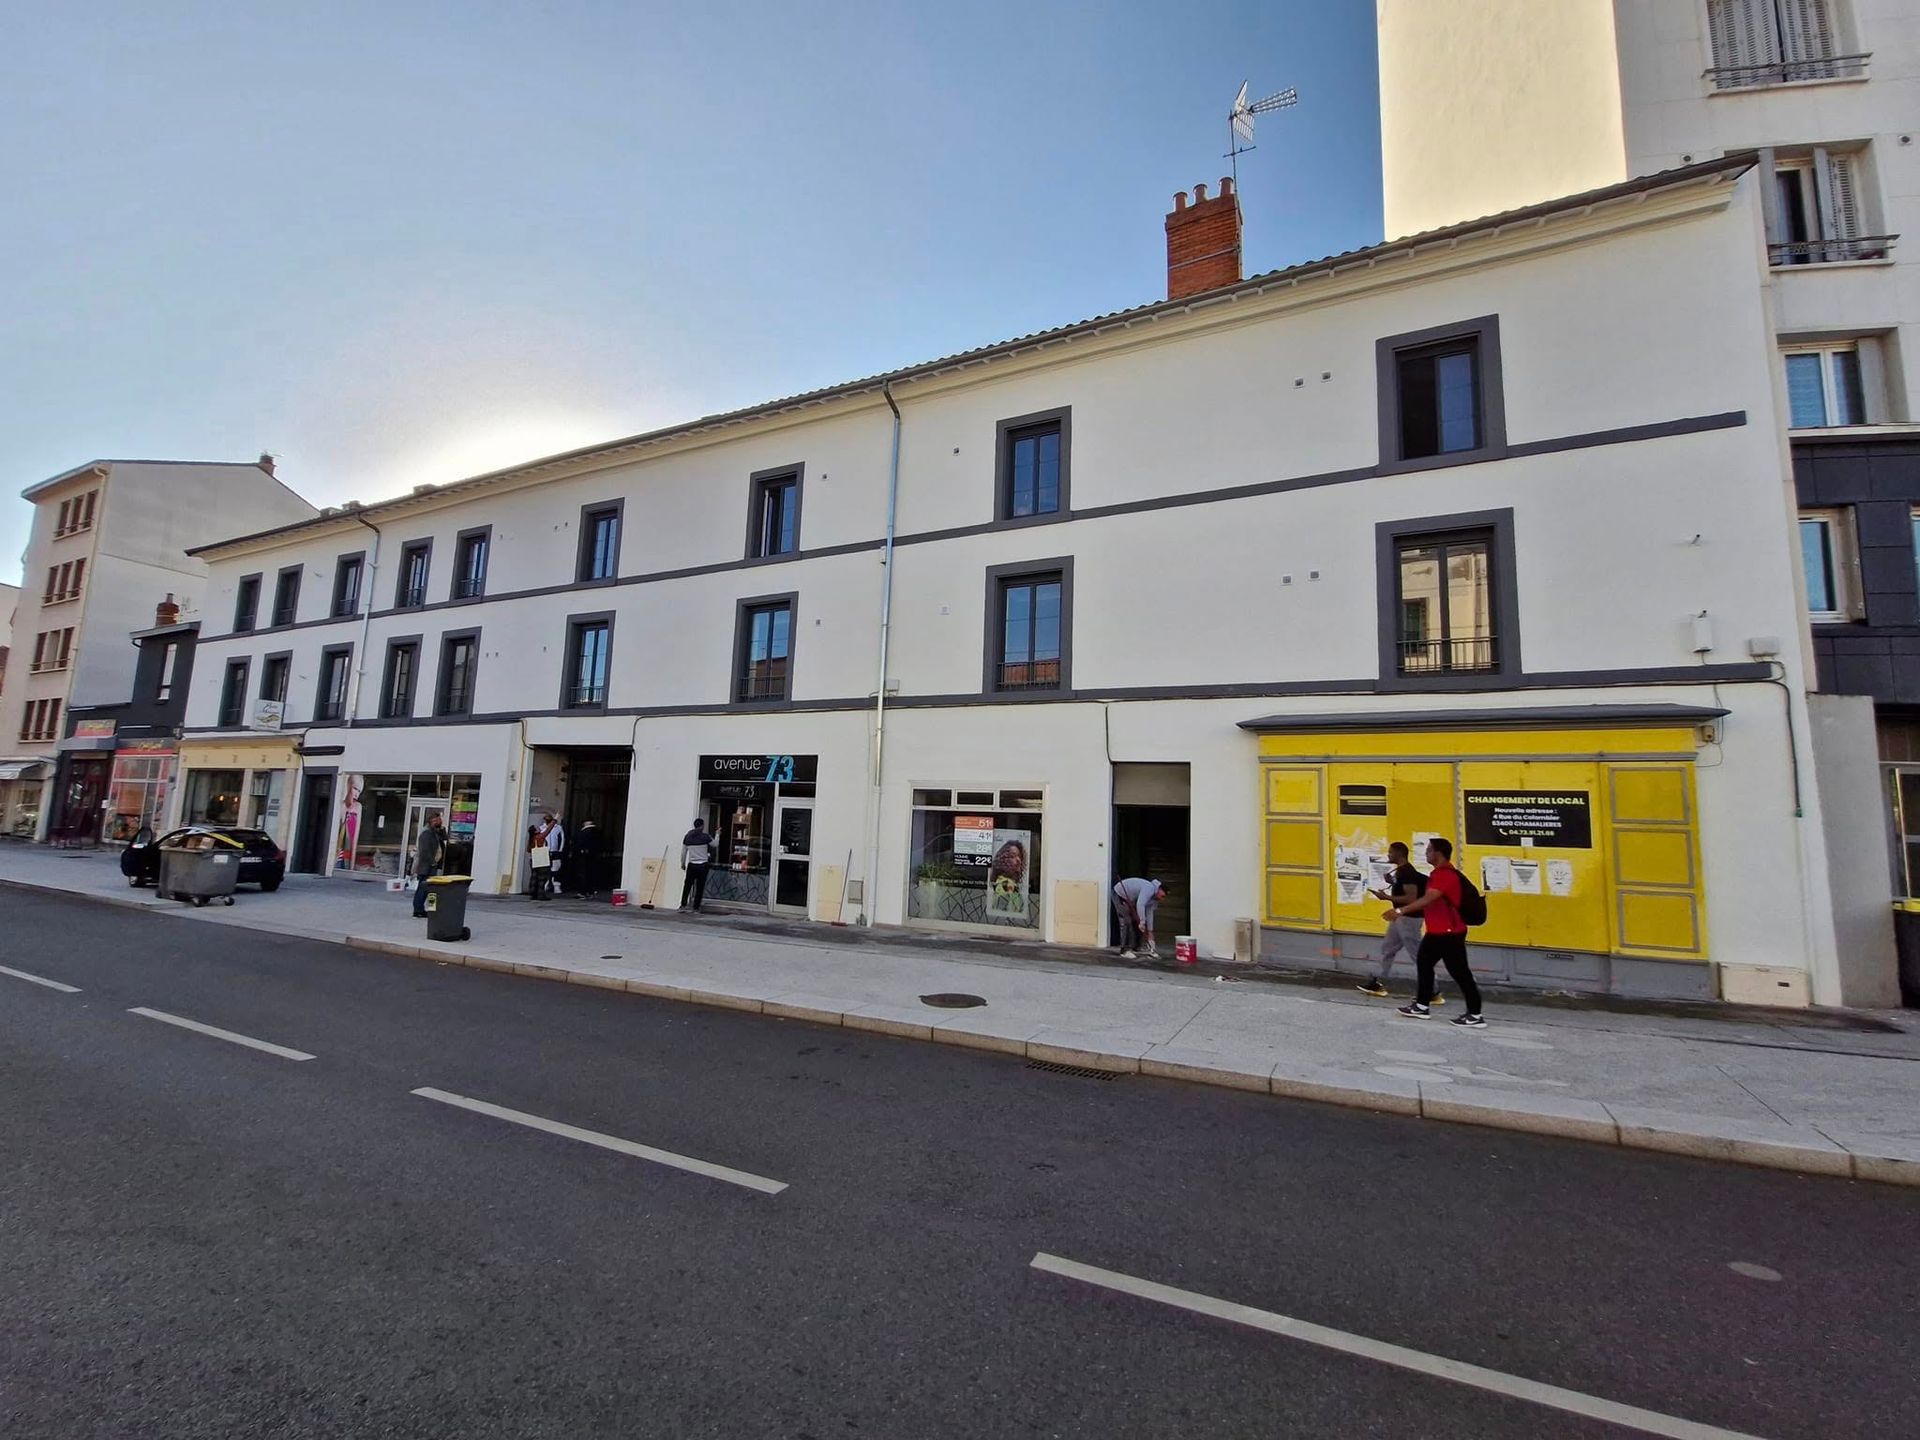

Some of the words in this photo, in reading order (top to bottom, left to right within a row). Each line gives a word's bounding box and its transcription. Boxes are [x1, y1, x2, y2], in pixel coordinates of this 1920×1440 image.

[713, 758, 761, 770] avenue
[765, 755, 794, 783] 73
[744, 785, 755, 798] 73
[1468, 796, 1536, 804] CHANGEMENT
[1537, 797, 1550, 805] DE
[1551, 797, 1585, 805] LOCAL
[975, 856, 992, 866] 22€
